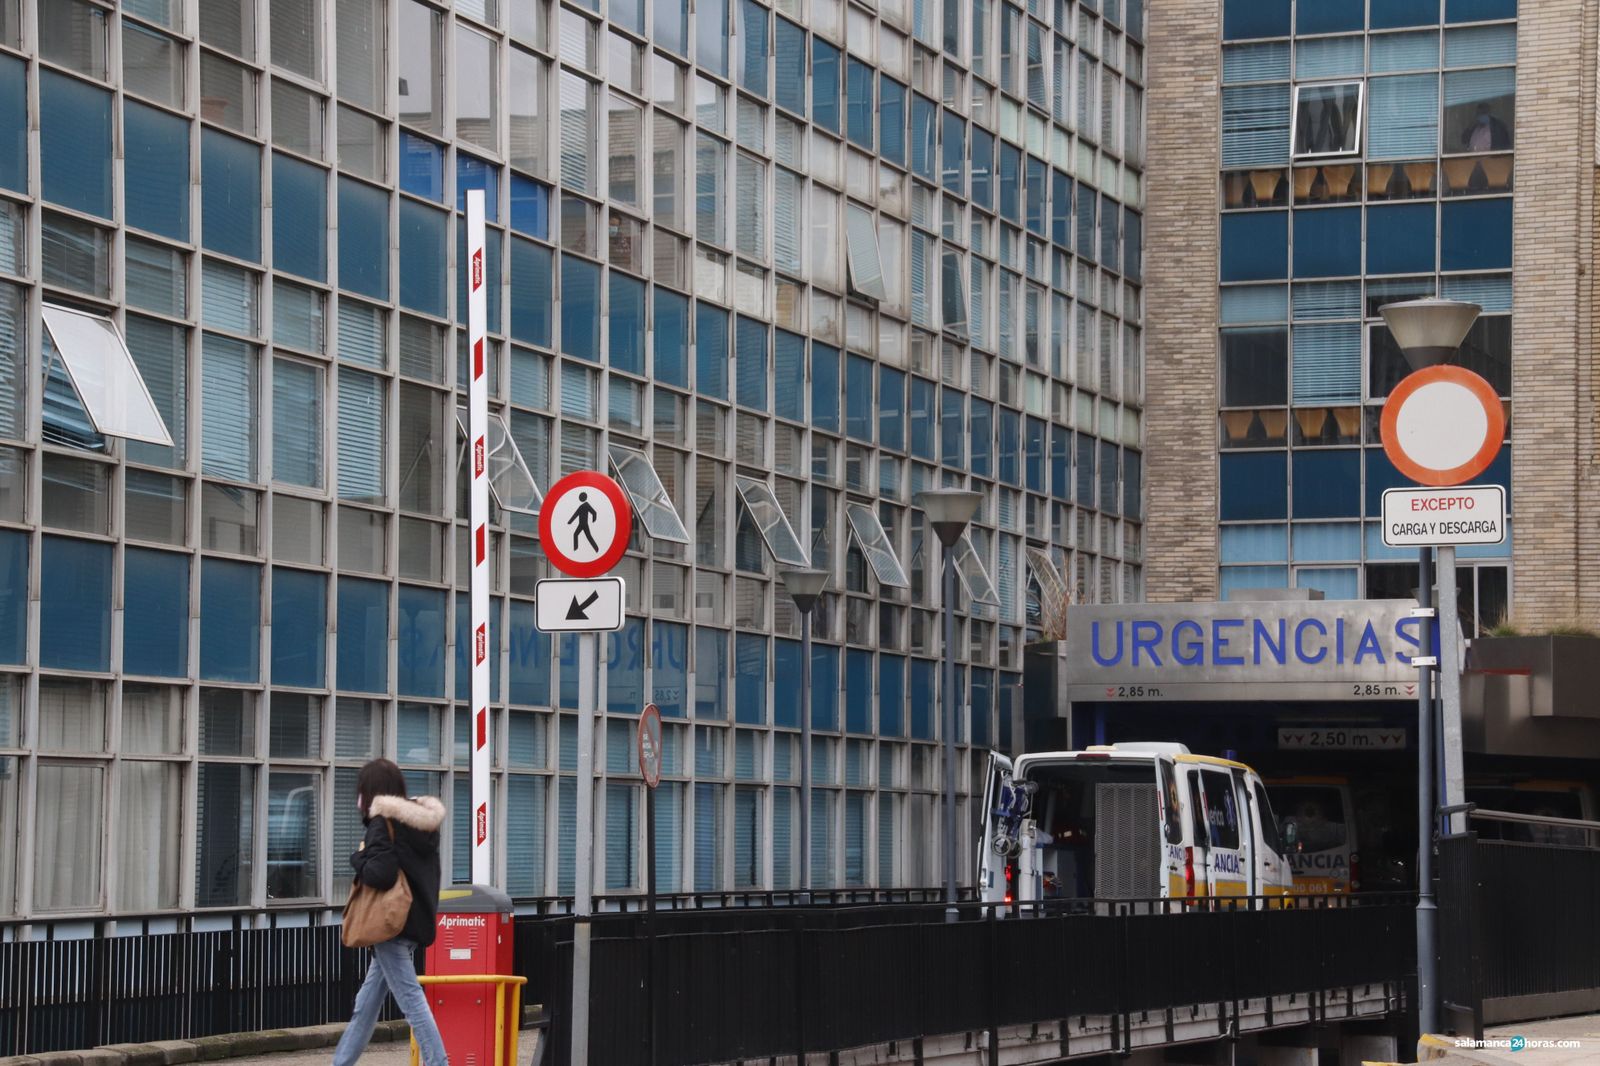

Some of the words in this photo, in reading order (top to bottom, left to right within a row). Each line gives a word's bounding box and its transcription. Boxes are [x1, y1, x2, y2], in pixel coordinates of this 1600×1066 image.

[474, 257, 482, 284] Aprimatic
[476, 443, 484, 471] Aprimatic
[1411, 497, 1475, 512] EXCEPTO
[1392, 522, 1428, 536] CARGA
[1429, 522, 1436, 535] Y
[1439, 520, 1497, 535] DESCARGA
[476, 631, 484, 658] Aprimatic
[1091, 617, 1420, 667] URGENCIAS
[1118, 686, 1144, 699] 2,85
[1147, 688, 1164, 698] m.
[1353, 684, 1381, 697] 2,85
[1384, 686, 1401, 696] m.
[1309, 731, 1346, 748] 2,50
[1352, 733, 1375, 747] m.
[477, 811, 485, 840] Aprimatic
[438, 915, 486, 929] Aprimatic
